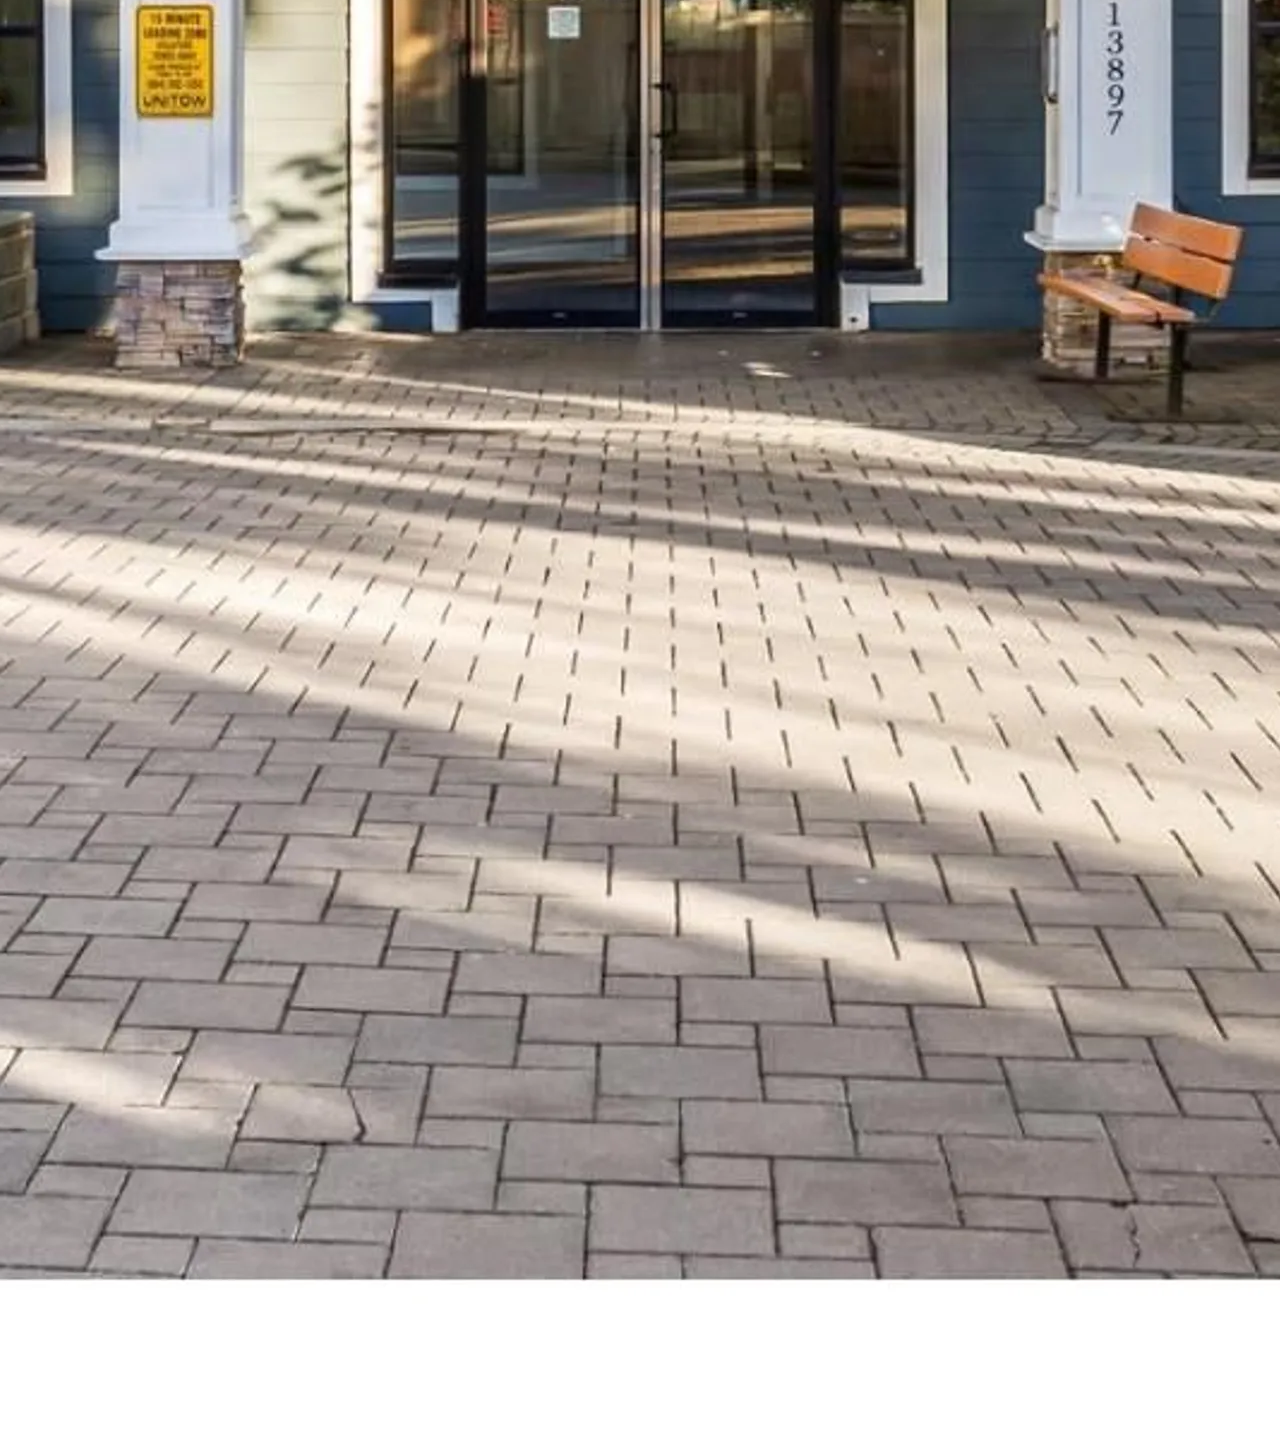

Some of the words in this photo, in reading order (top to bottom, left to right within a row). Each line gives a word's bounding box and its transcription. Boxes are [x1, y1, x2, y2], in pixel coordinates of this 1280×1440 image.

[166, 13, 200, 25] MINUTE
[143, 27, 181, 39] LOADING
[1106, 2, 1125, 136] 13897
[143, 95, 207, 108] UNITOW
